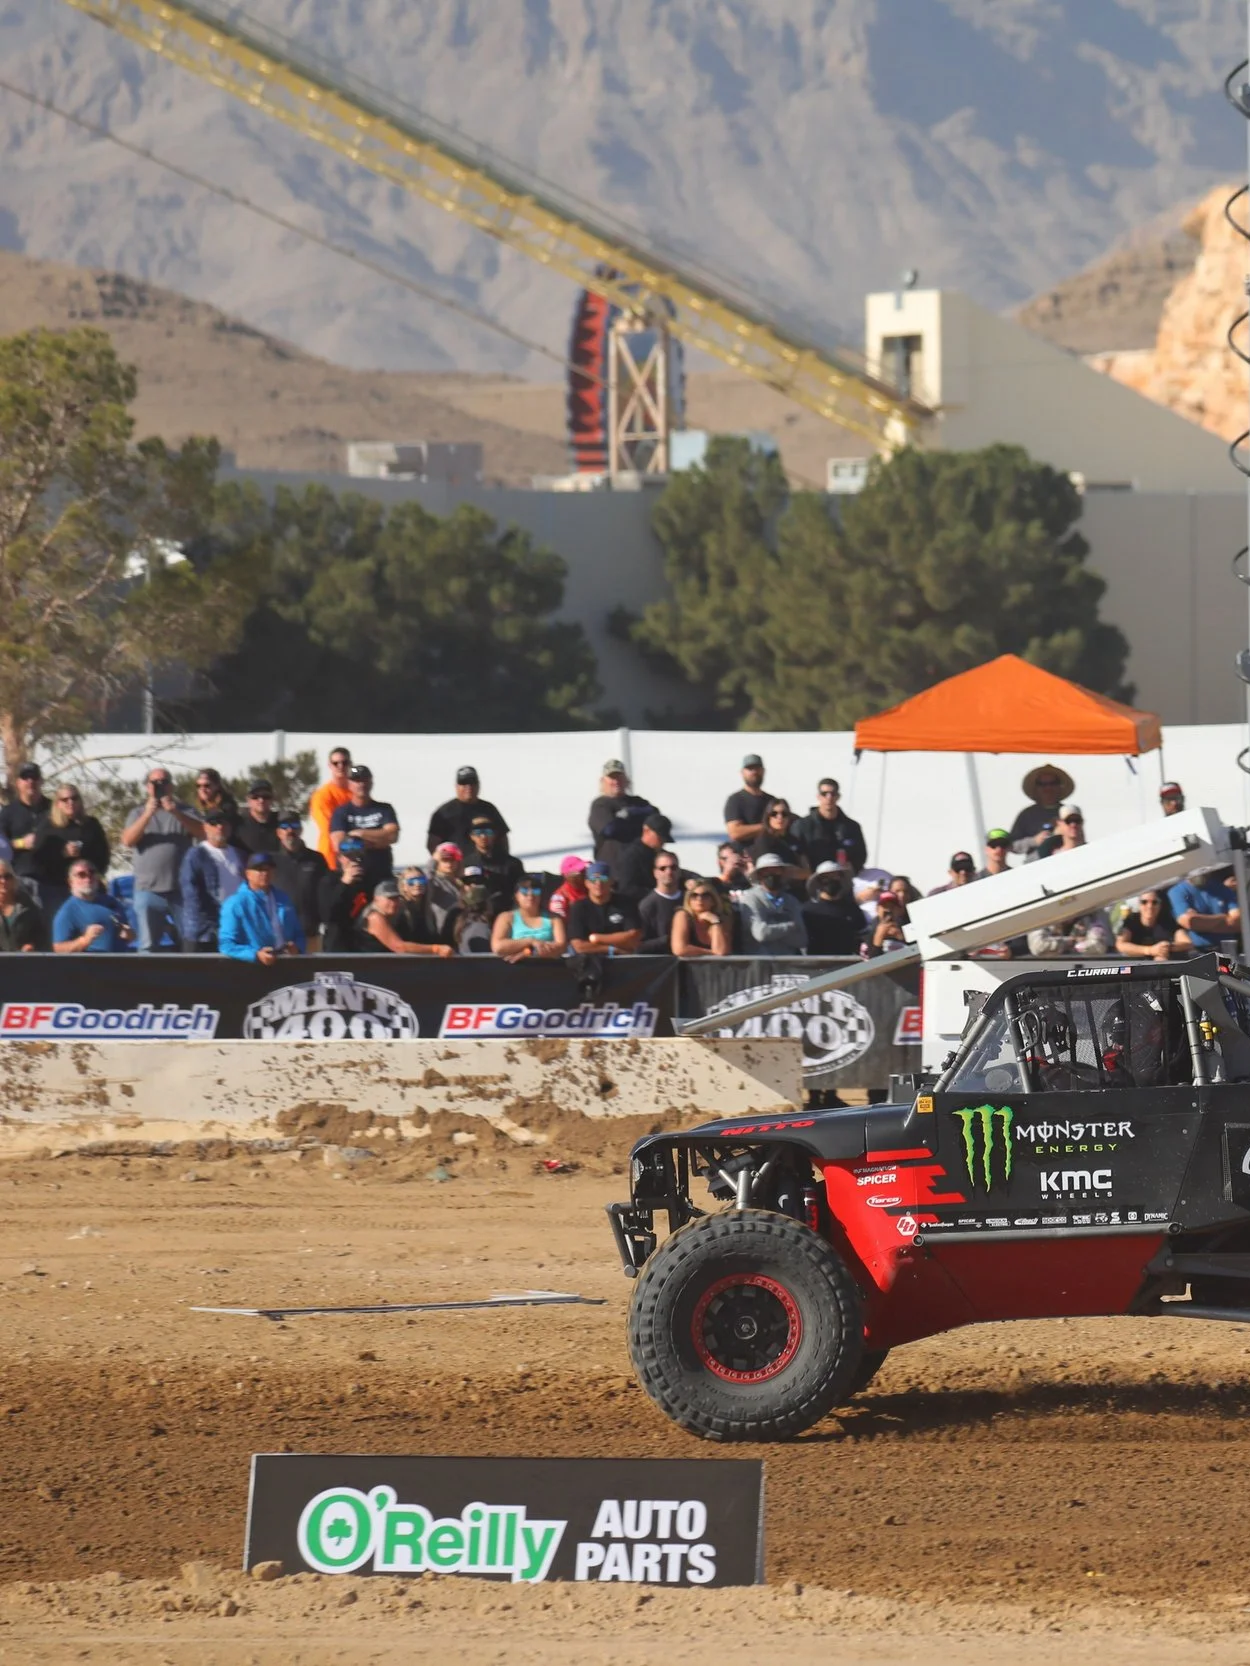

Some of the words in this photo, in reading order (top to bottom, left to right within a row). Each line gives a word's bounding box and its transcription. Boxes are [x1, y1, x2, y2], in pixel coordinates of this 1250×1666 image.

[2, 1005, 216, 1031] BFGoodrich
[273, 1010, 389, 1039] 400
[445, 1002, 654, 1030] BFGoodrich
[1015, 1119, 1136, 1143] MONSTER
[1035, 1143, 1118, 1154] ENERGY
[856, 1173, 897, 1186] SPICER
[1041, 1191, 1113, 1200] WHEELS
[591, 1499, 707, 1539] AUTO
[303, 1489, 560, 1581] O'Reilly
[574, 1543, 717, 1583] PARTS
